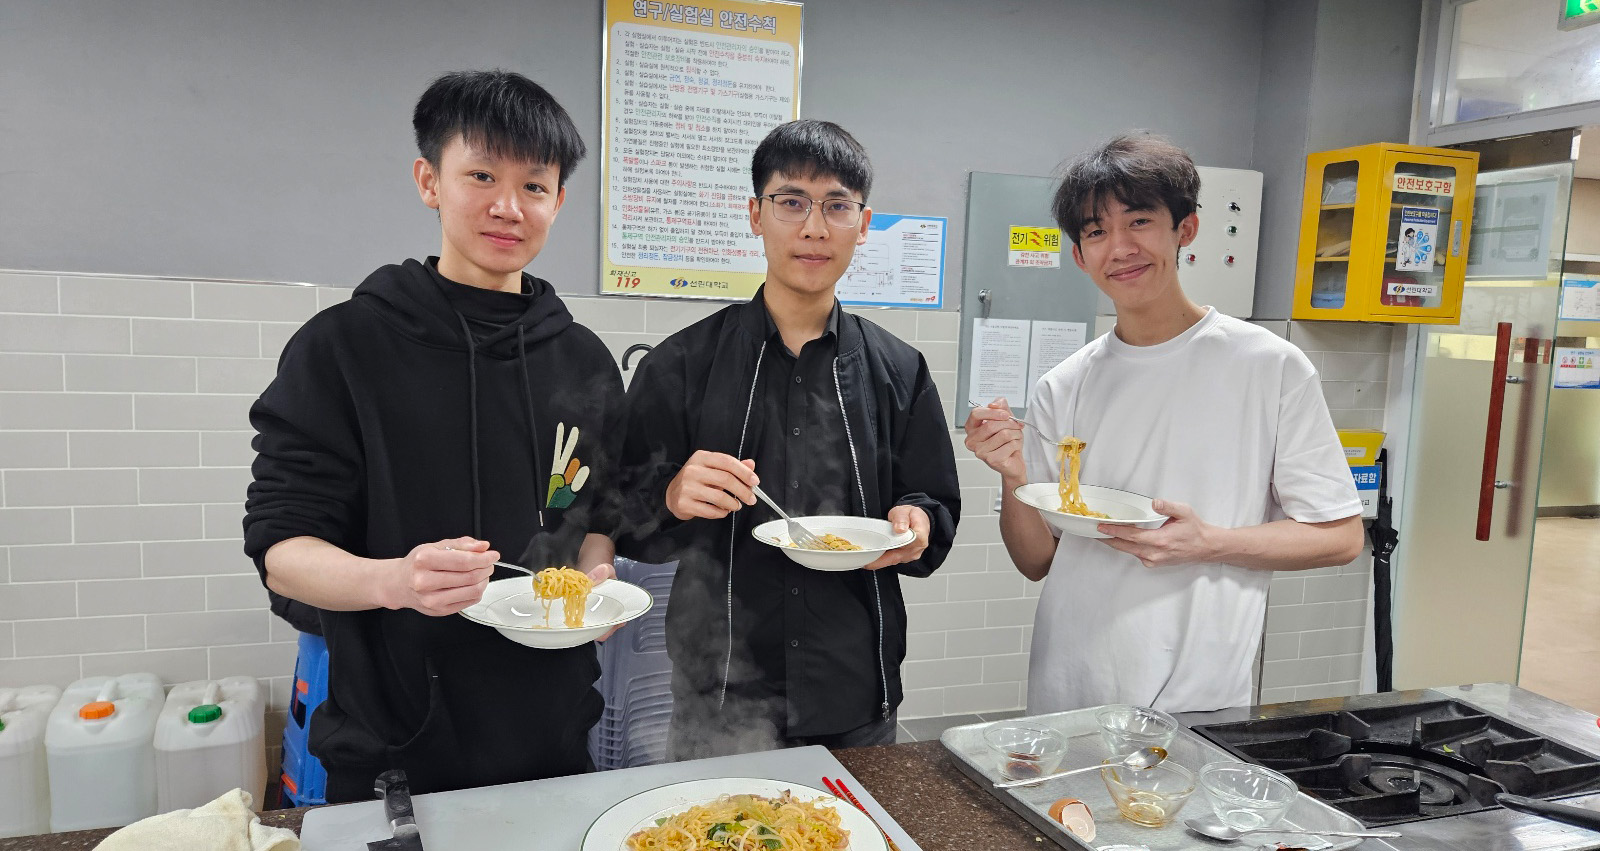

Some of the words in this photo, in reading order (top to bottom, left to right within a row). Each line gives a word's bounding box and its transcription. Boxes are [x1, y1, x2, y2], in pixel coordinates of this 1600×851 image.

[633, 0, 714, 27] 연구/실험실
[719, 10, 776, 34] 안전수칙
[1397, 177, 1451, 193] 안전보호구함
[1012, 232, 1028, 245] 전기
[1043, 234, 1059, 246] 위험
[610, 269, 637, 277] 화재신고
[617, 277, 640, 288] 119
[1353, 473, 1376, 484] 자료함
